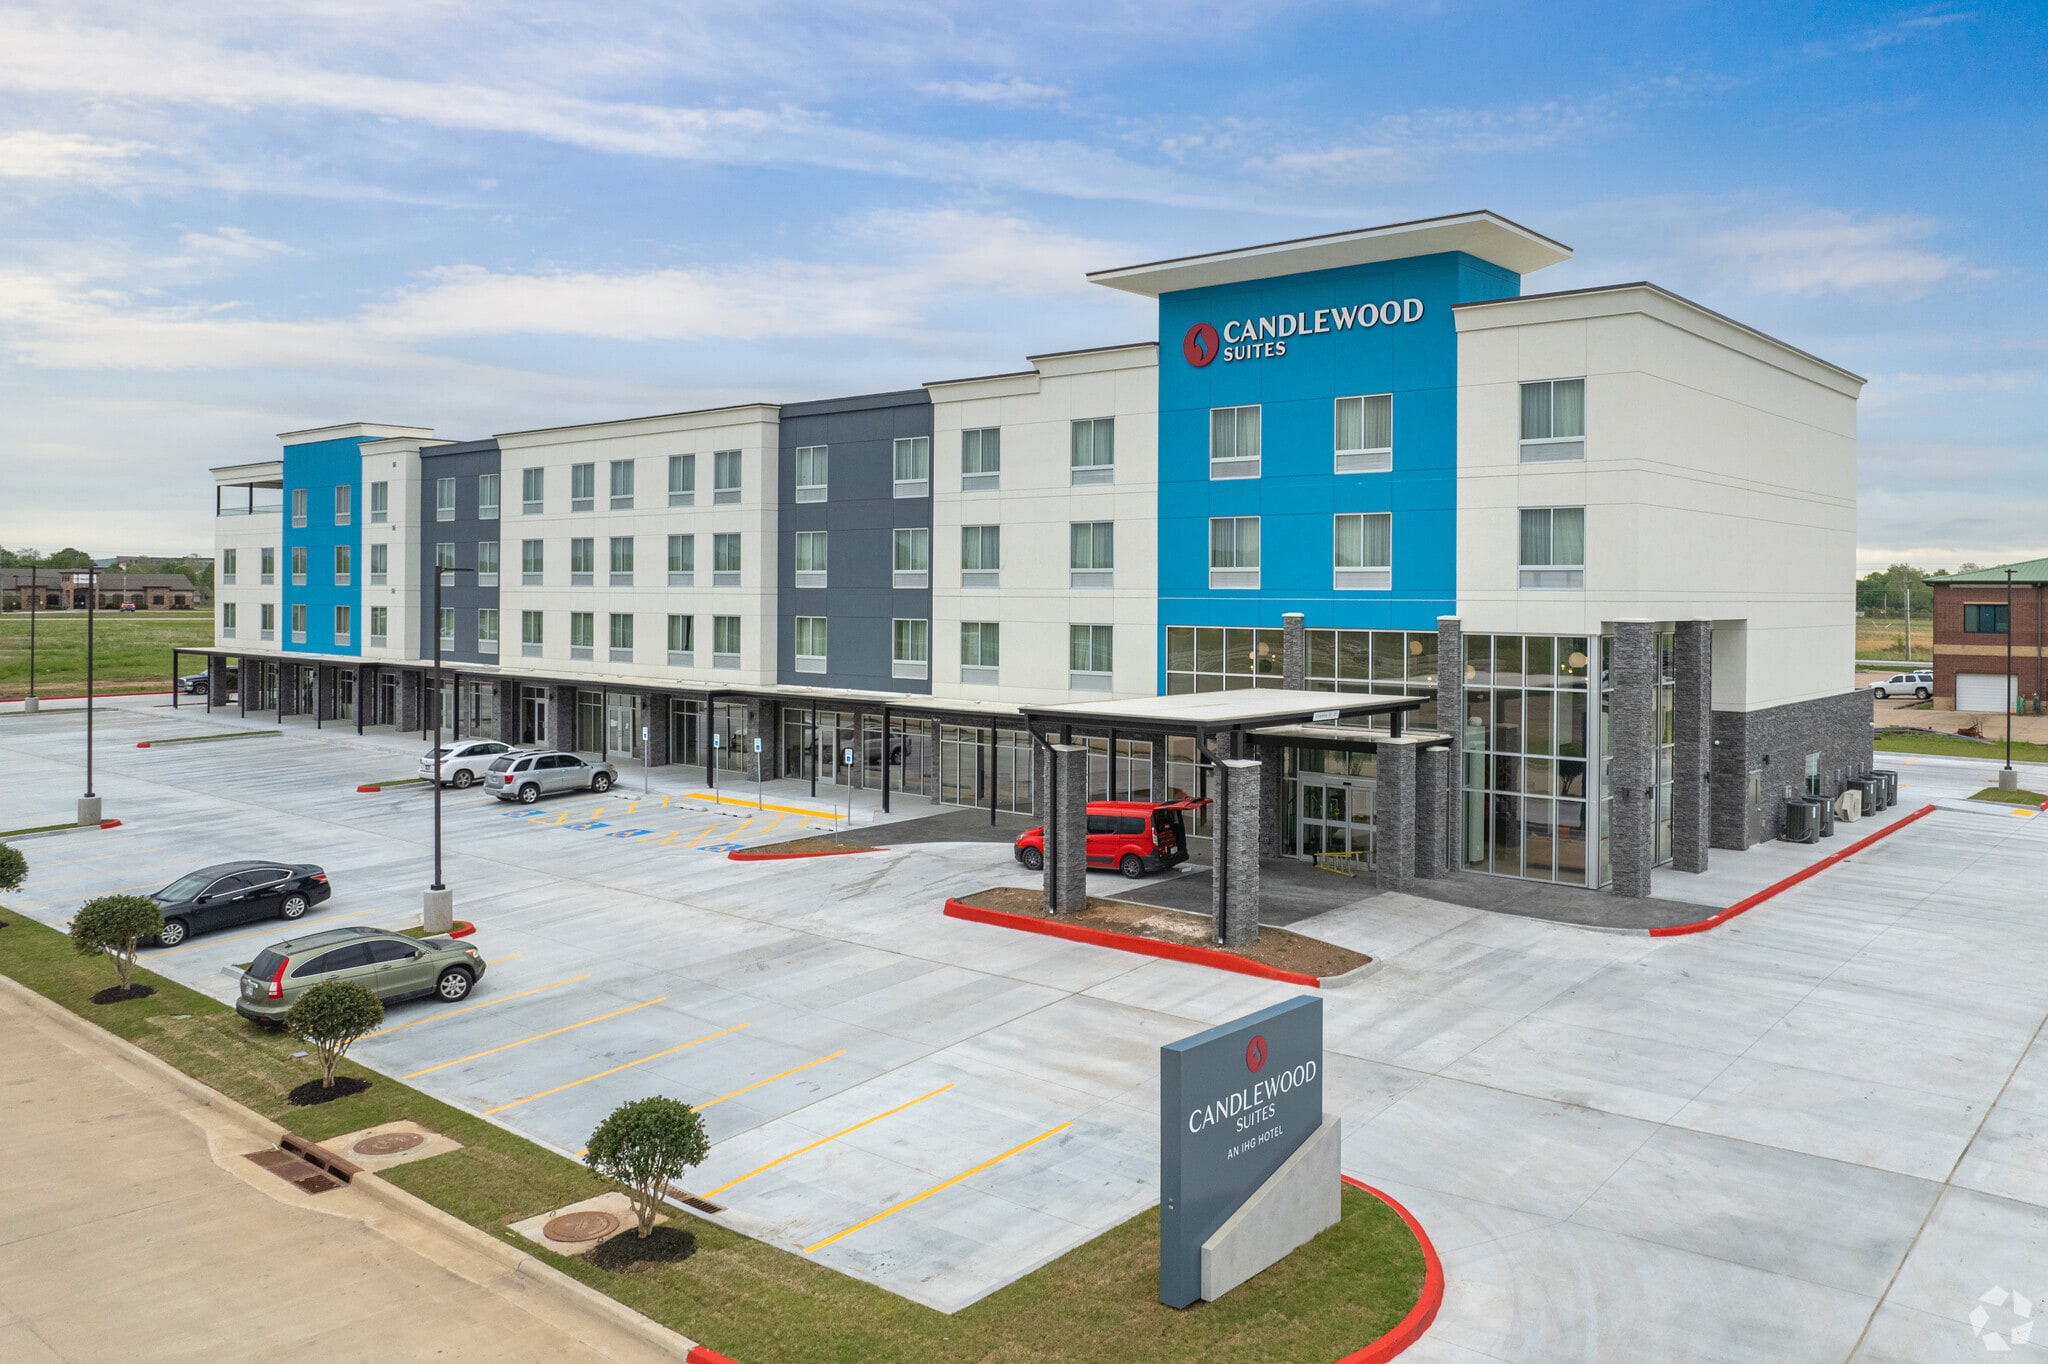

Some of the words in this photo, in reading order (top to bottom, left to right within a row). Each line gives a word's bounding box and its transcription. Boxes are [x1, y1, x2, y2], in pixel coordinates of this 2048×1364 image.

[1223, 298, 1423, 343] CANDLEWOOD
[1223, 341, 1286, 362] SUITES
[1189, 1061, 1316, 1133] CANDLEWOOD
[1236, 1103, 1275, 1132] SUITES
[1227, 1145, 1240, 1160] AN
[1241, 1137, 1256, 1153] IHG
[1258, 1125, 1283, 1144] HOTEL
